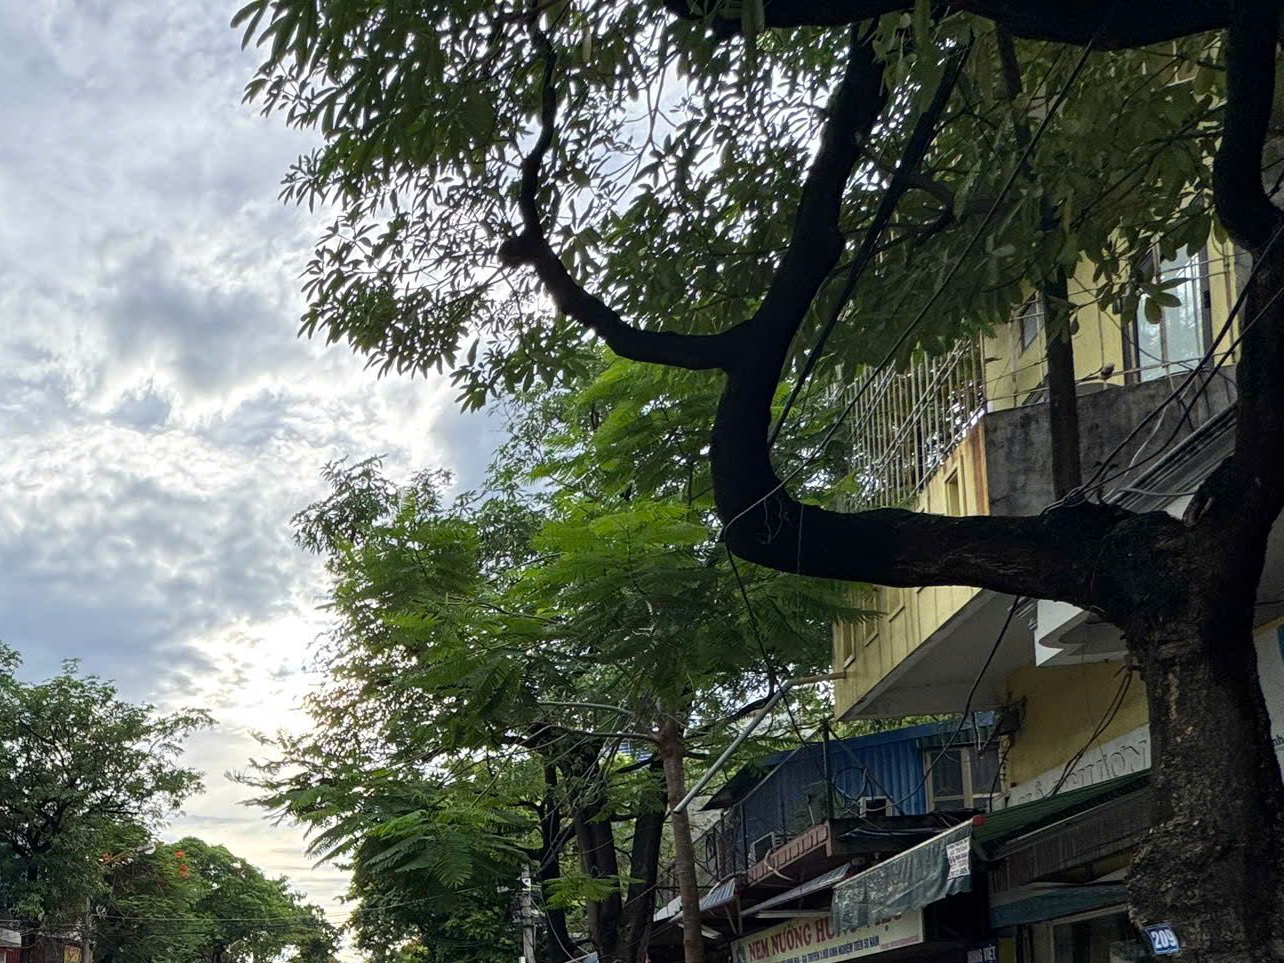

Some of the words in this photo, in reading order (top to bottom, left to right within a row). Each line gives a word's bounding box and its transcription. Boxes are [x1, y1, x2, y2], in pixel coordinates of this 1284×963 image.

[748, 936, 769, 962] NEM
[770, 923, 813, 956] NƯỚNG
[1152, 929, 1177, 949] 209
